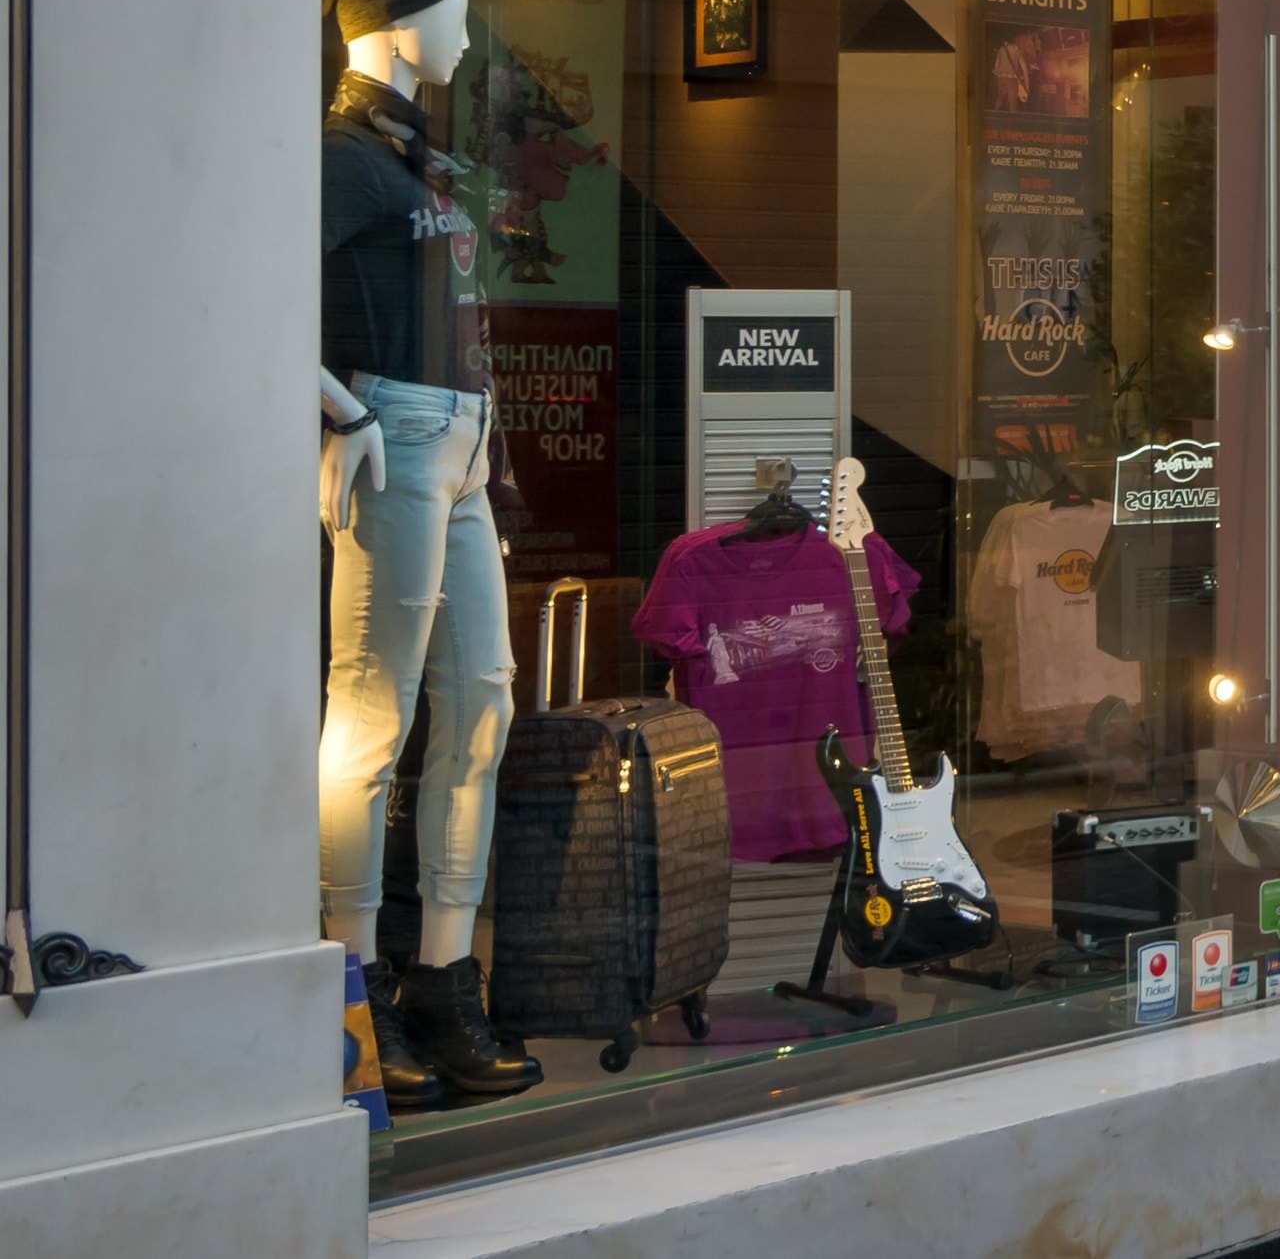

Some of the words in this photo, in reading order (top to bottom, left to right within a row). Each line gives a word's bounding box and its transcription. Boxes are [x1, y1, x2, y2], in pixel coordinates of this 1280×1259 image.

[987, 257, 1053, 290] THIS
[1056, 258, 1080, 290] IS
[738, 328, 800, 347] NEW
[982, 314, 1038, 342] Hard
[1038, 314, 1086, 347] Rock
[717, 347, 819, 368] ARRIVAL
[1023, 349, 1051, 362] CAFE
[1036, 558, 1074, 579] Hard
[1075, 557, 1096, 576] Ro
[853, 787, 863, 803] All
[858, 804, 868, 831] Serve
[865, 851, 875, 875] Love
[1145, 983, 1172, 998] Ticket
